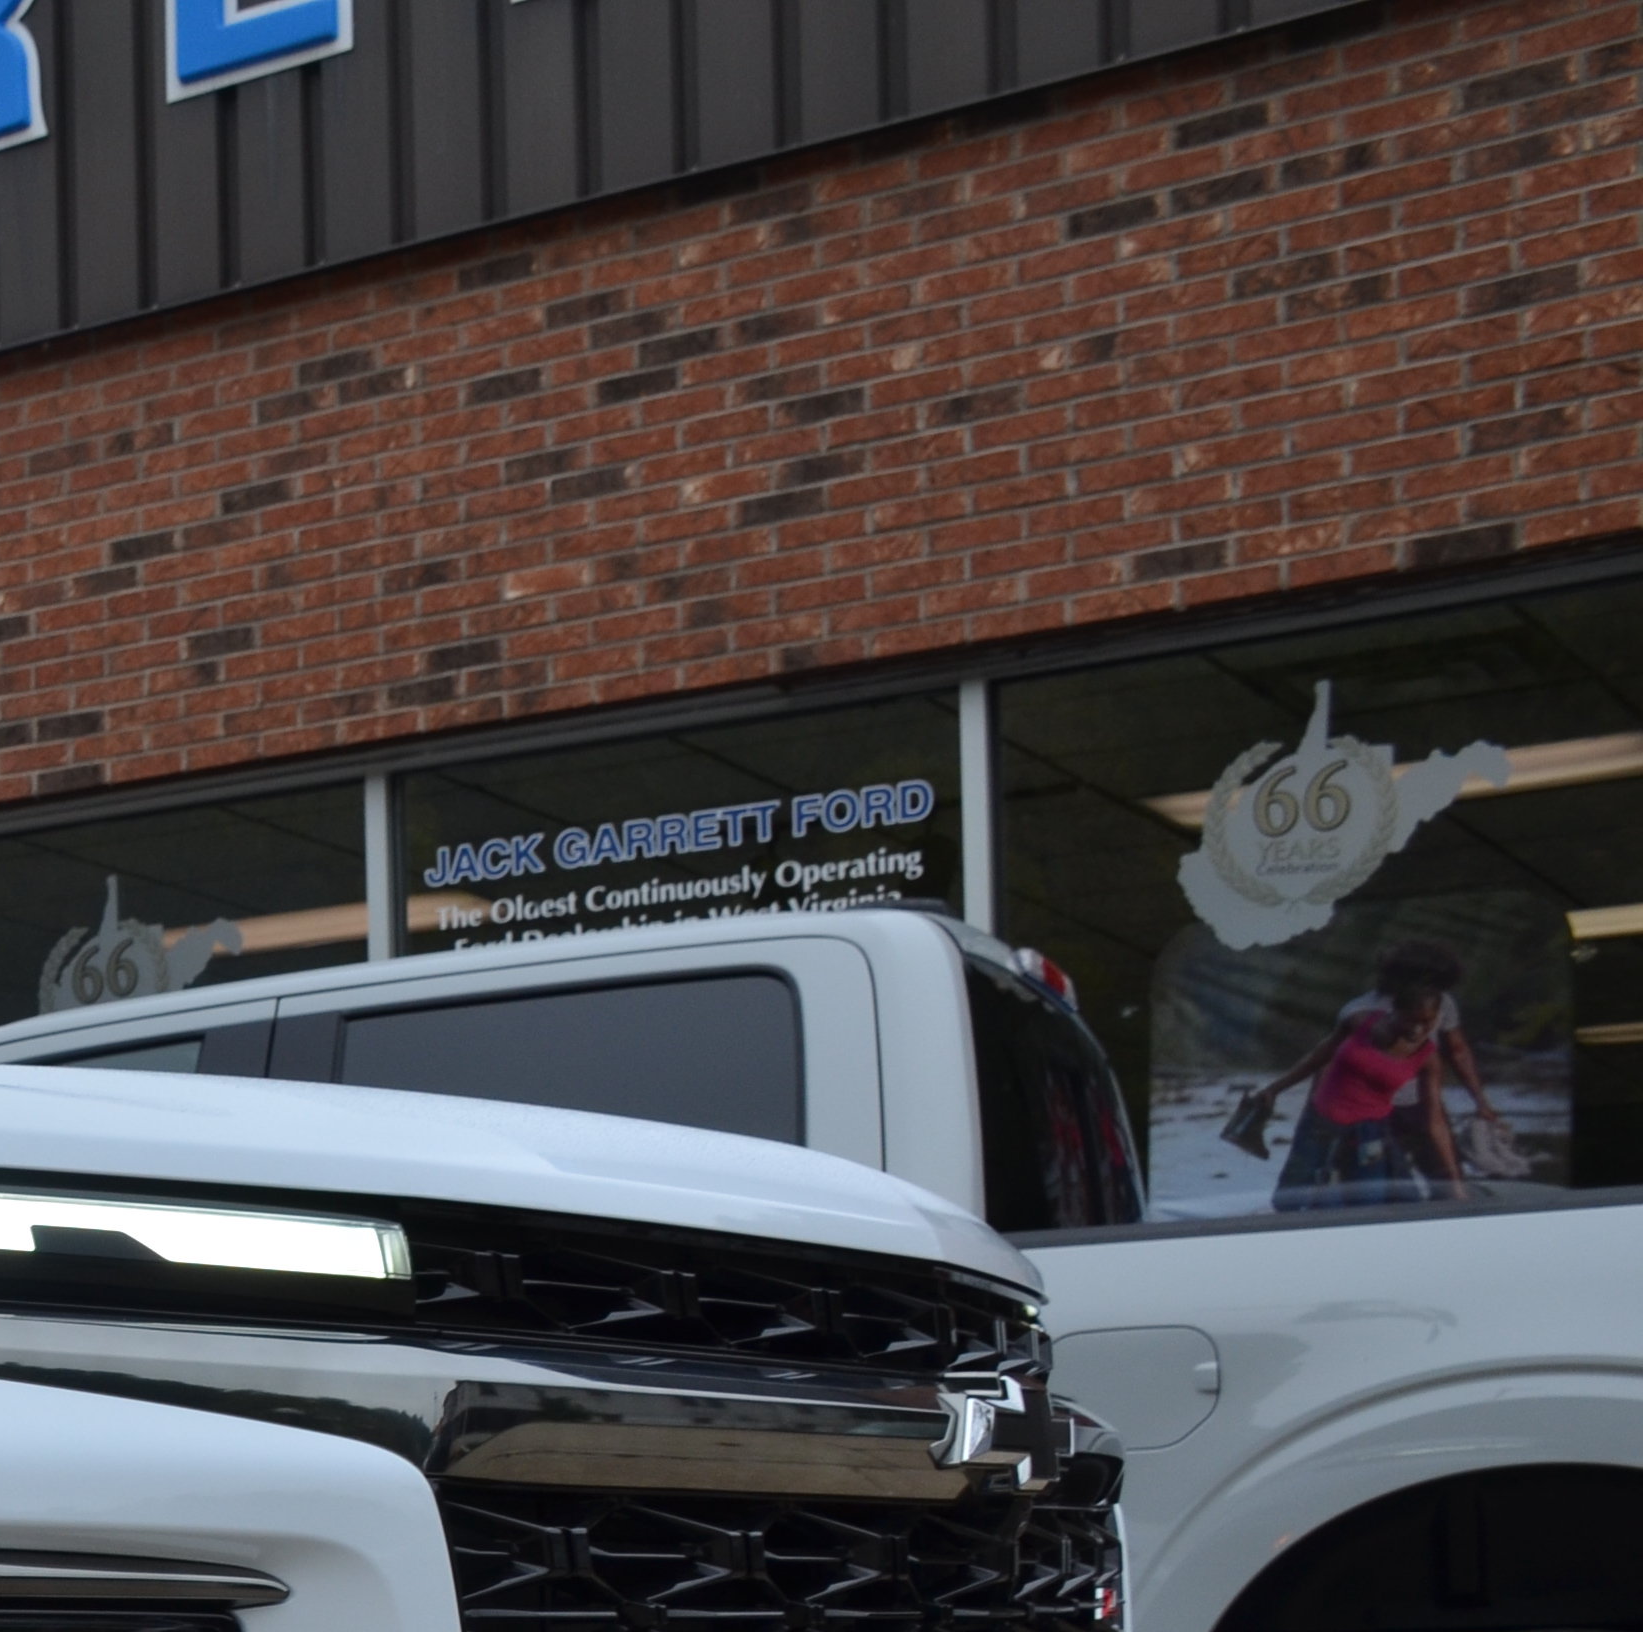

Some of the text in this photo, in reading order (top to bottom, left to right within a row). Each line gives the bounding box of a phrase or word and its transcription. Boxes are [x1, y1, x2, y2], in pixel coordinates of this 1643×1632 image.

[424, 778, 934, 888] JACK GARRETT FORD
[1253, 759, 1351, 837] 66
[436, 904, 482, 931] The
[584, 864, 767, 913] Continuously
[775, 847, 924, 892] Operating
[1257, 837, 1341, 864] YEARS
[72, 937, 139, 1005] 66
